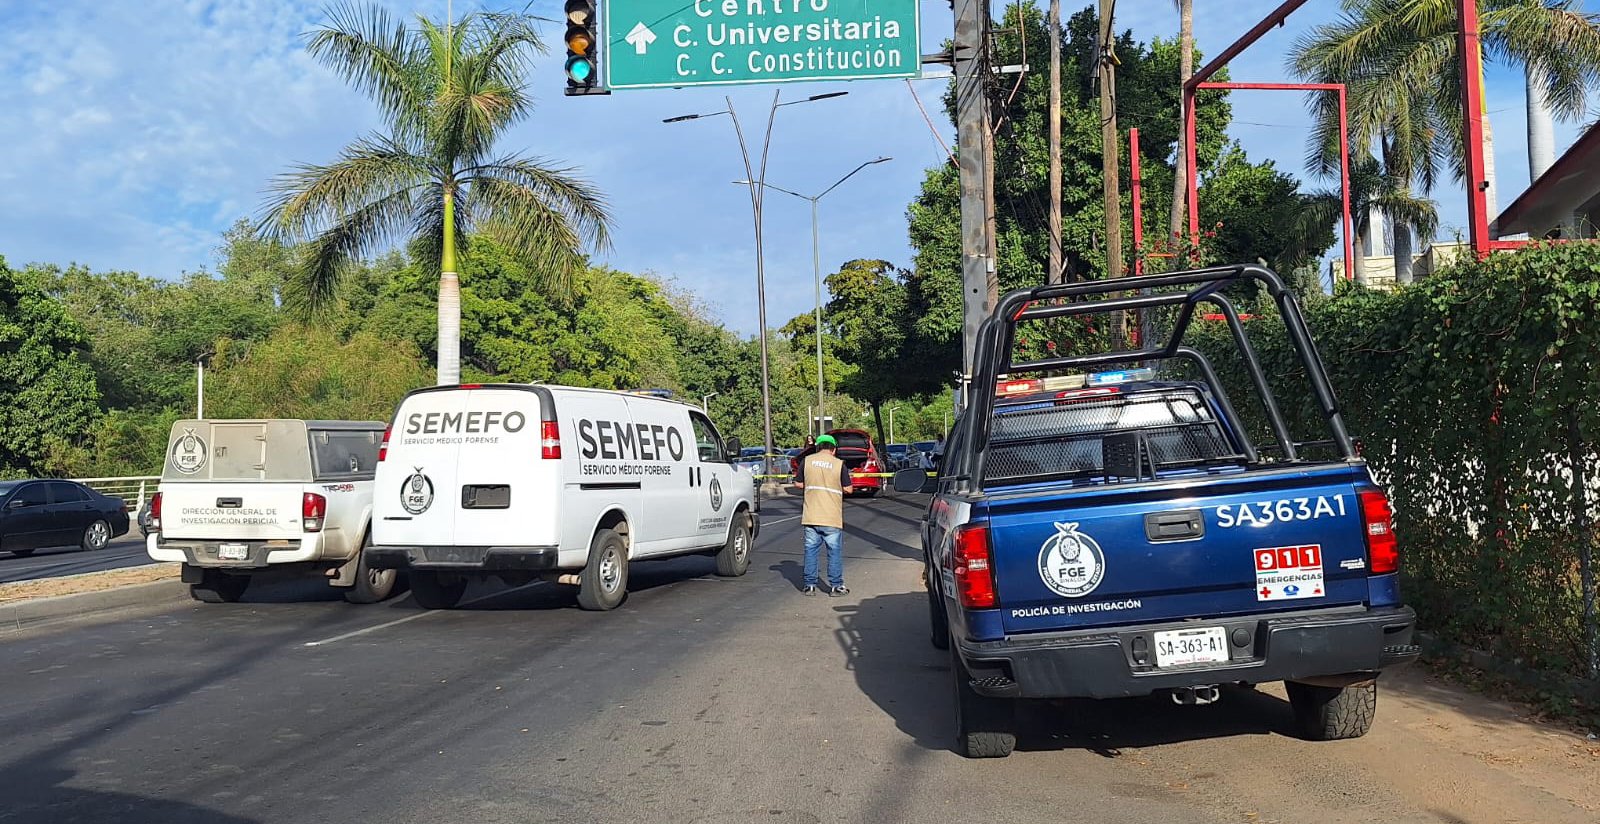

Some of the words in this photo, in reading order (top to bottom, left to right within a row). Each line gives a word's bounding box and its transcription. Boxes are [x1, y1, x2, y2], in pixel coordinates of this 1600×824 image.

[694, 0, 829, 17] Centro
[673, 26, 698, 47] C.
[706, 15, 901, 46] Universitaria
[675, 54, 697, 76] C.
[711, 52, 733, 75] C.
[748, 43, 901, 73] Constitución
[406, 411, 526, 435] SEMEFO
[404, 437, 435, 445] SERVICIO
[578, 418, 684, 462] SEMEFO
[583, 464, 617, 476] SERVICIO
[618, 462, 644, 476] MÉDICO
[644, 465, 672, 476] FORENSE
[409, 495, 425, 503] FGE
[226, 507, 264, 516] GENERAL
[265, 508, 278, 516] DE
[1216, 494, 1346, 527] SA363A1
[1058, 566, 1086, 579] FGE
[1257, 573, 1323, 585] EMERGENCIAS
[1011, 606, 1050, 618] POLICÍA
[1052, 605, 1066, 615] DE
[1067, 599, 1142, 615] INVESTIGACIÓN
[1158, 636, 1223, 656] SA-363-A1
